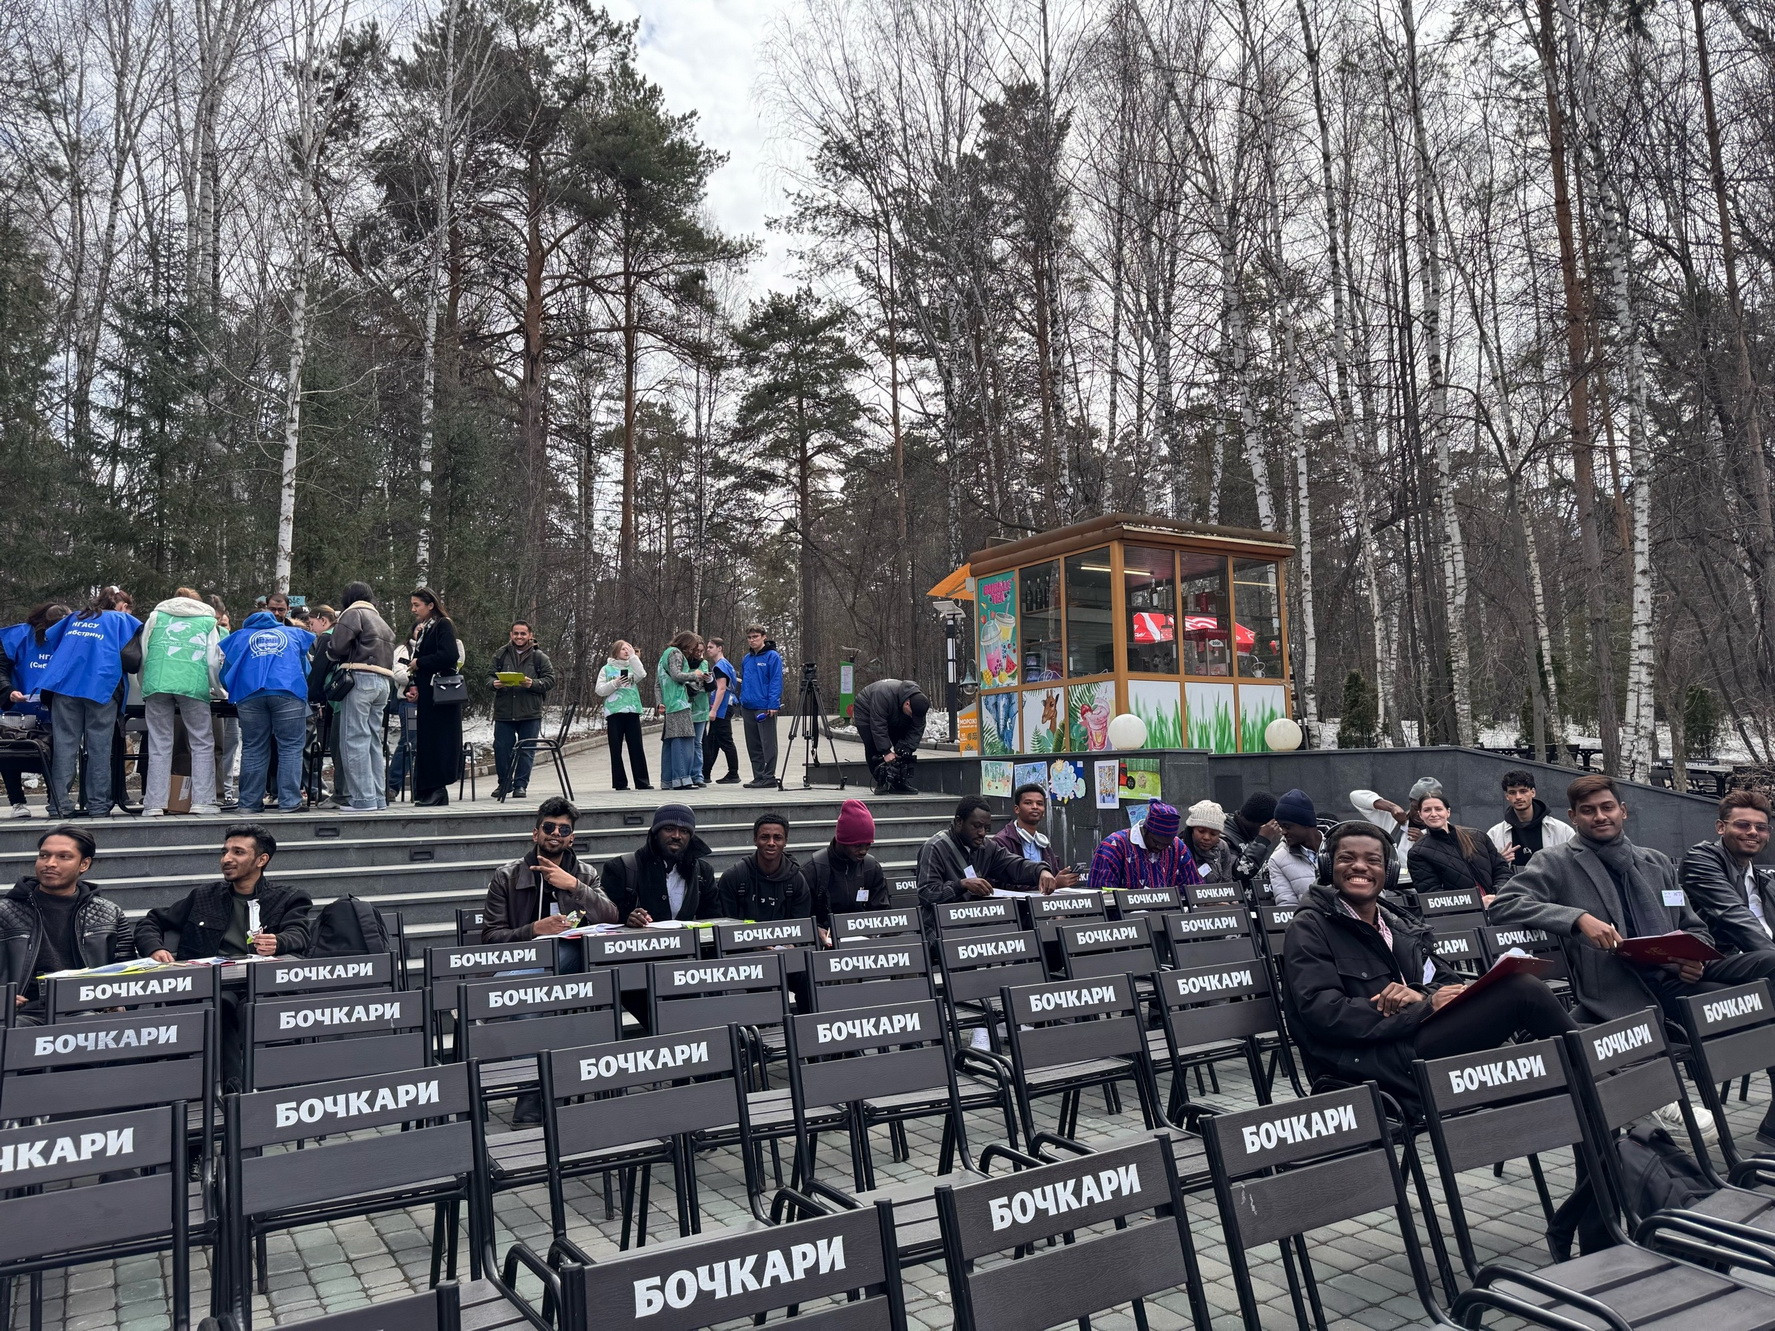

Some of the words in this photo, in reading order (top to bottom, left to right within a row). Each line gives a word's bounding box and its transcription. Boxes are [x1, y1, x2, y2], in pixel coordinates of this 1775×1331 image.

[1042, 892, 1093, 912] БОЧКАРИ
[1127, 892, 1171, 905] БОЧКАРИ
[1195, 887, 1236, 899] БОЧКАРИ
[1428, 895, 1472, 908] БОЧКАРИ
[847, 914, 908, 931] БОЧКАРИ
[949, 904, 1005, 920] БОЧКАРИ
[733, 925, 802, 942] БОЧКАРИ
[1075, 925, 1137, 944] БОЧКАРИ
[1181, 917, 1237, 932] БОЧКАРИ
[604, 936, 681, 954] БОЧКАРИ
[958, 936, 1025, 959] БОЧКАРИ
[1434, 939, 1469, 954] КАРИ
[1496, 931, 1547, 945] БОЧКАРИ
[450, 948, 537, 968] БОЧКАРИ
[829, 952, 910, 972] БОЧКАРИ
[275, 962, 373, 983] БОЧКАРИ
[674, 965, 763, 985] БОЧКАРИ
[1177, 970, 1253, 994] БОЧКАРИ
[79, 976, 193, 1001] БОЧКАРИ
[489, 982, 593, 1007] БОЧКАРИ
[1028, 985, 1117, 1012] БОЧКАРИ
[280, 1002, 400, 1029] БОЧКАРИ
[1703, 993, 1763, 1023] БОЧКАРИ
[816, 1012, 921, 1044] БОЧКАРИ
[35, 1025, 177, 1055] БОЧКАРИ
[1594, 1024, 1652, 1060] БОЧКАРИ
[579, 1041, 709, 1081] БОЧКАРИ
[1448, 1054, 1547, 1093] БОЧКАРИ
[275, 1080, 440, 1128] БОЧКАРИ
[1242, 1104, 1358, 1154] БОЧКАРИ
[990, 1163, 1142, 1232] БОЧКАРИ
[633, 1235, 847, 1318] БОЧКАРИ
